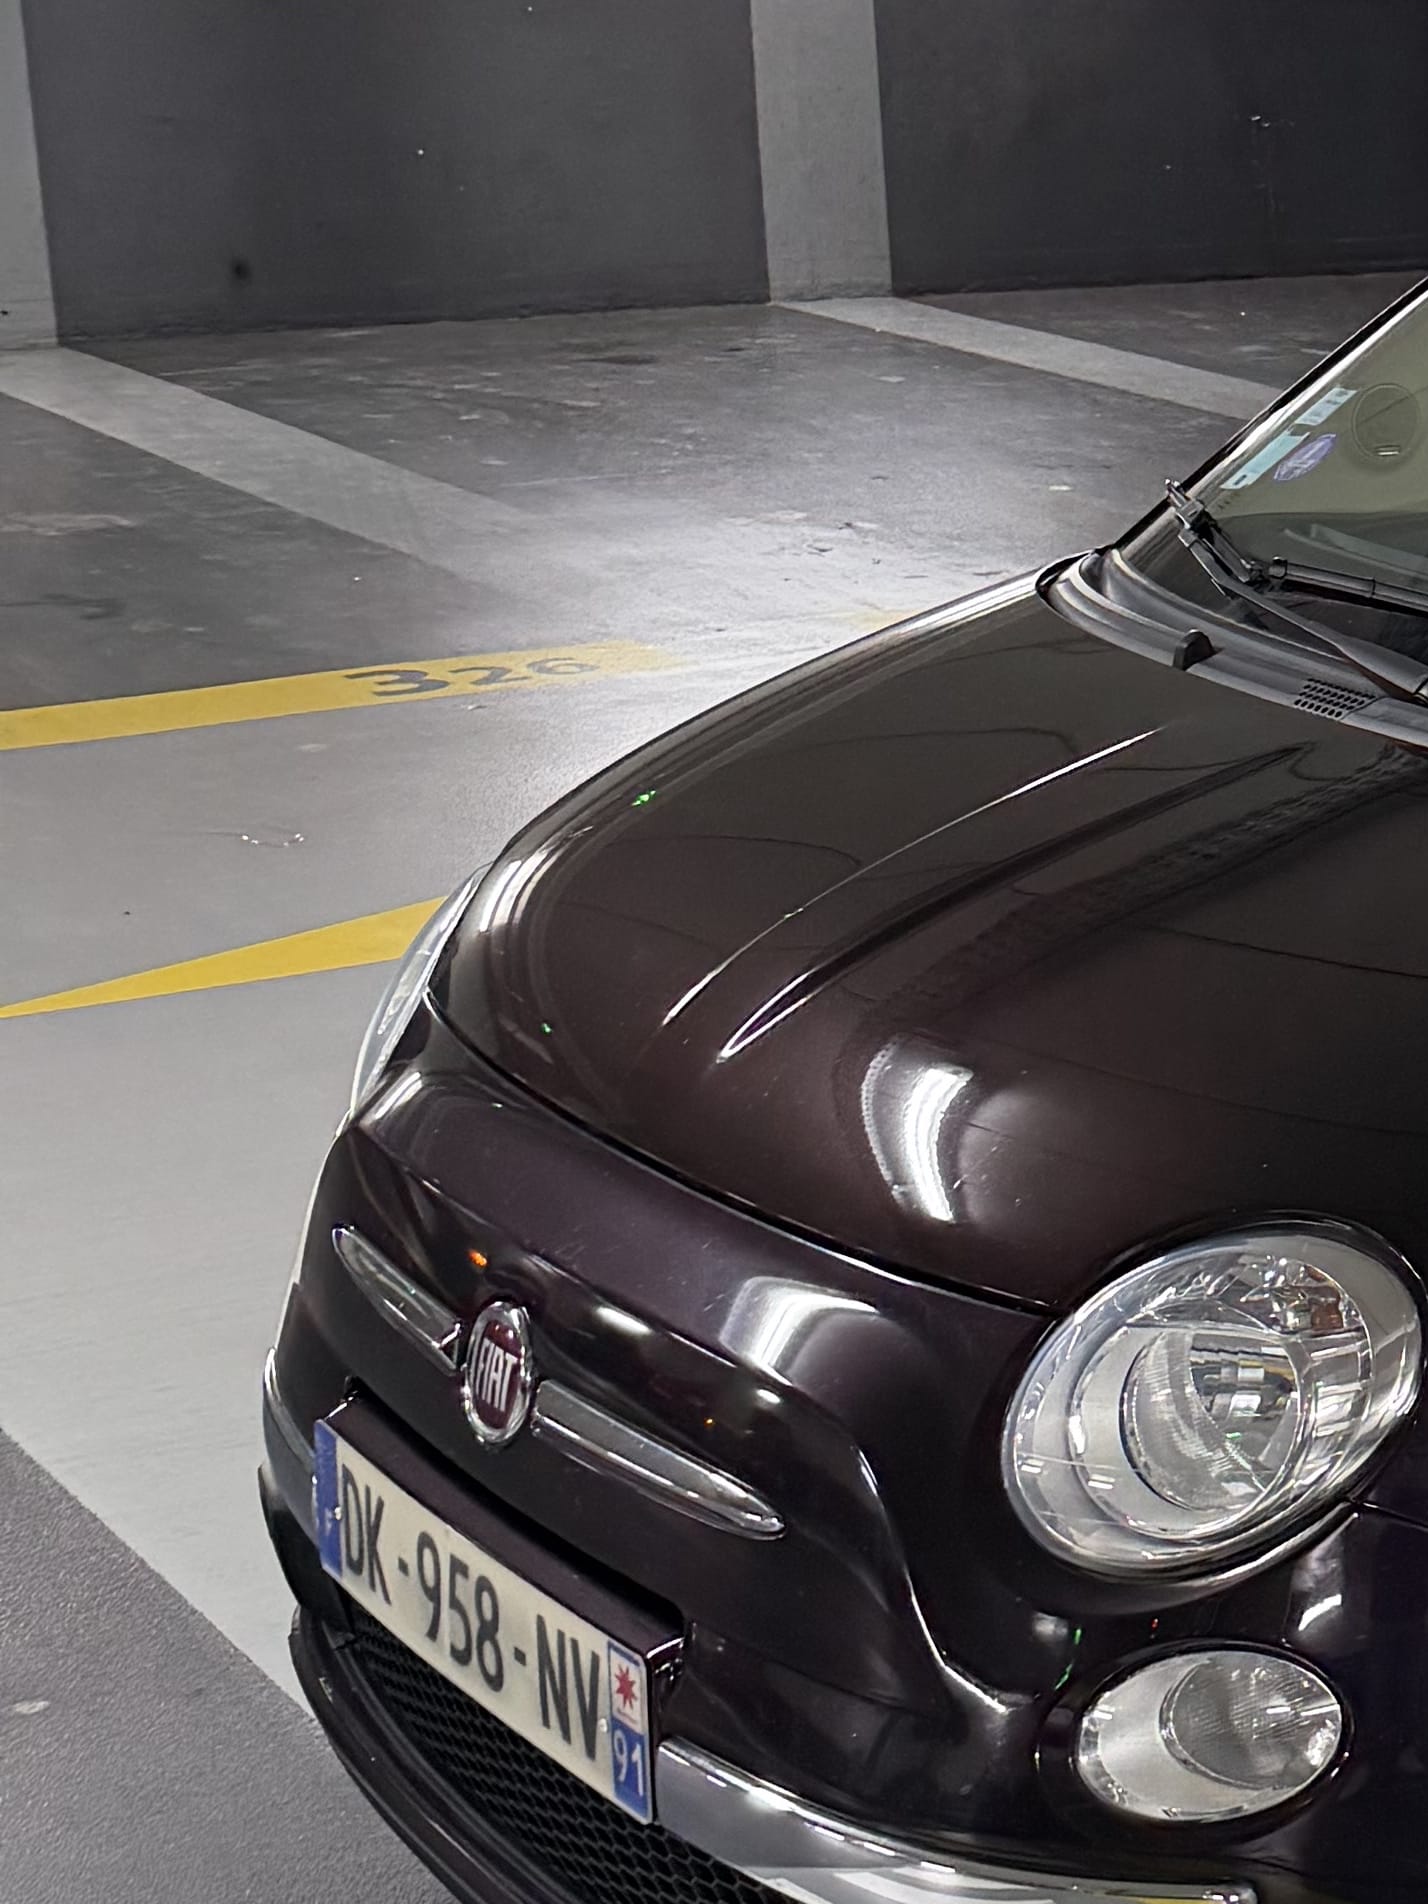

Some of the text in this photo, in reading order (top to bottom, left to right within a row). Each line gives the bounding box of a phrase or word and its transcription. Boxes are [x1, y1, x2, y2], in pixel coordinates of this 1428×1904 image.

[345, 656, 601, 697] 326
[476, 1337, 519, 1413] FIAT
[341, 1463, 601, 1761] DK-958-NV
[614, 1728, 645, 1797] 91
